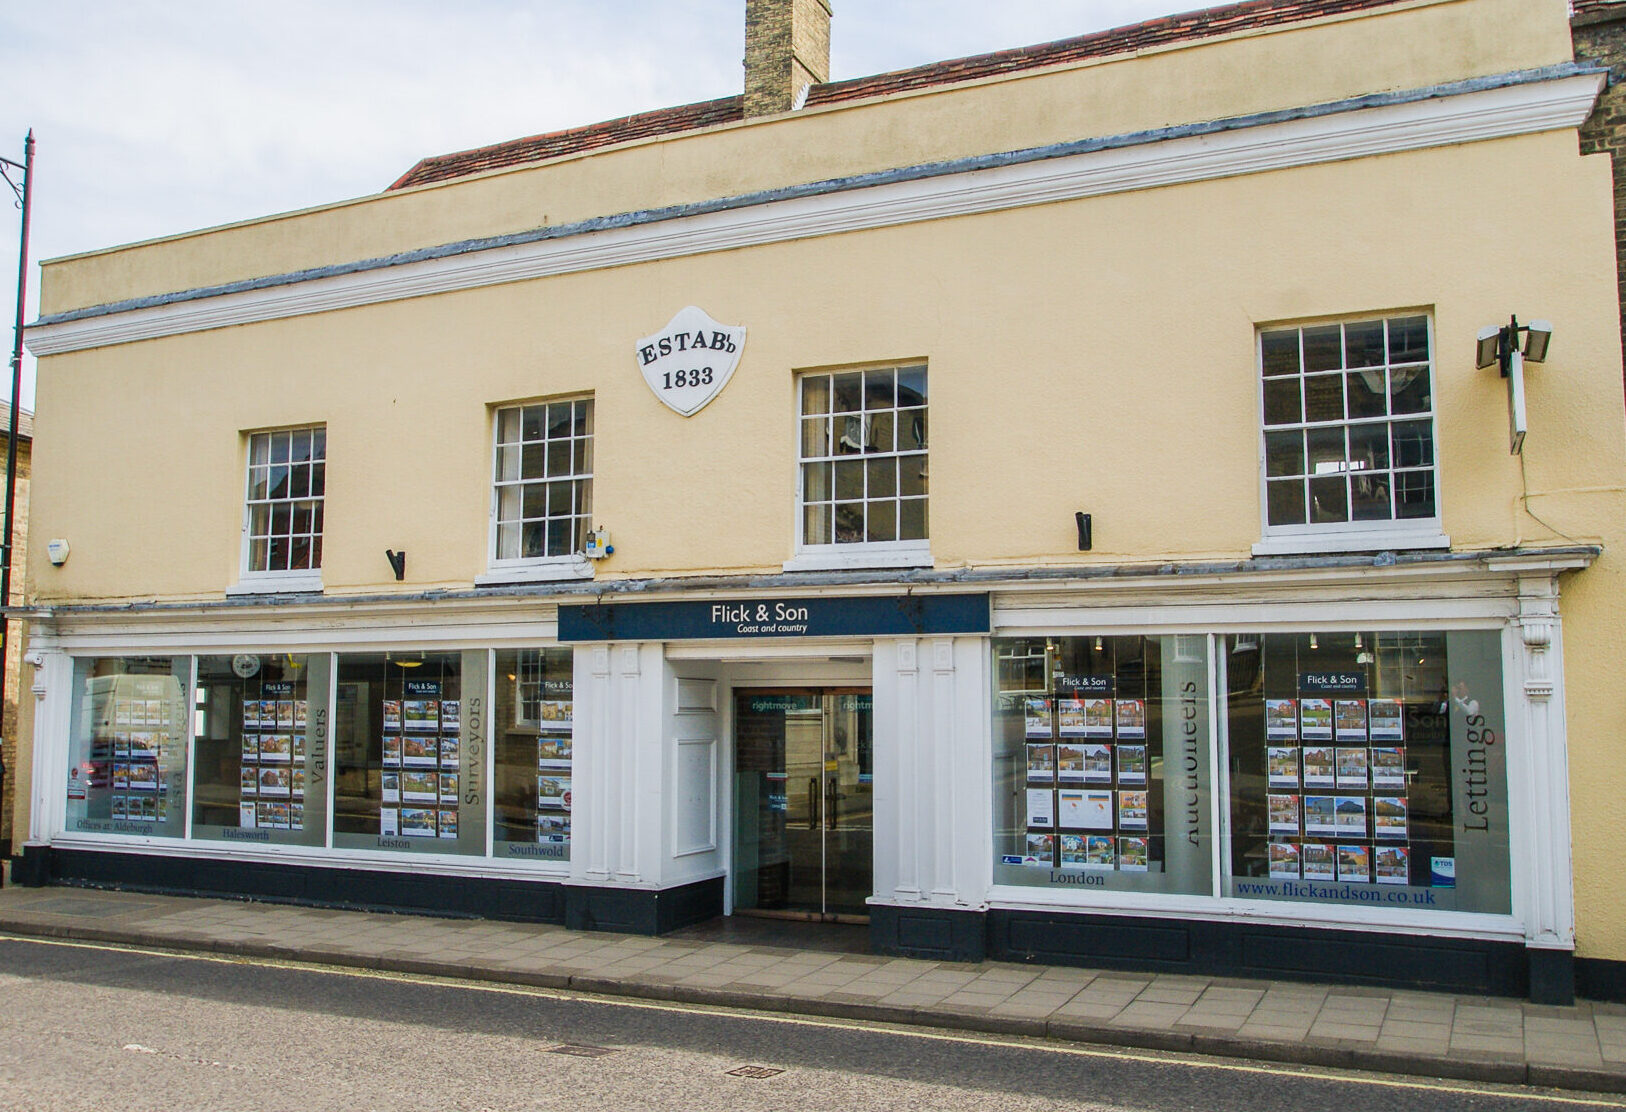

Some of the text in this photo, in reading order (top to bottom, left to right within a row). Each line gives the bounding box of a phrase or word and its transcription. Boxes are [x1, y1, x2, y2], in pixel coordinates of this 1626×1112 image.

[663, 366, 713, 390] 1833
[712, 603, 808, 623] Flick & Son
[737, 622, 808, 634] Coast and country
[427, 682, 437, 690] Son
[544, 681, 558, 689] Flick
[1062, 678, 1107, 686] Flick & Son
[1307, 675, 1357, 684] Flick & Son
[752, 701, 797, 712] rightmove
[843, 700, 873, 711] rightm
[311, 708, 327, 785] Valuers
[465, 697, 484, 805] Surveyors
[1183, 682, 1199, 847] Auctioneers
[1463, 713, 1495, 833] Lettings
[113, 821, 153, 834] Aldeburgh
[222, 828, 270, 841] Halesworth
[377, 837, 411, 849] Leiston
[508, 844, 564, 857] Southwold
[1049, 871, 1105, 886] London
[1238, 882, 1436, 905] www.flickandson.co.uk
